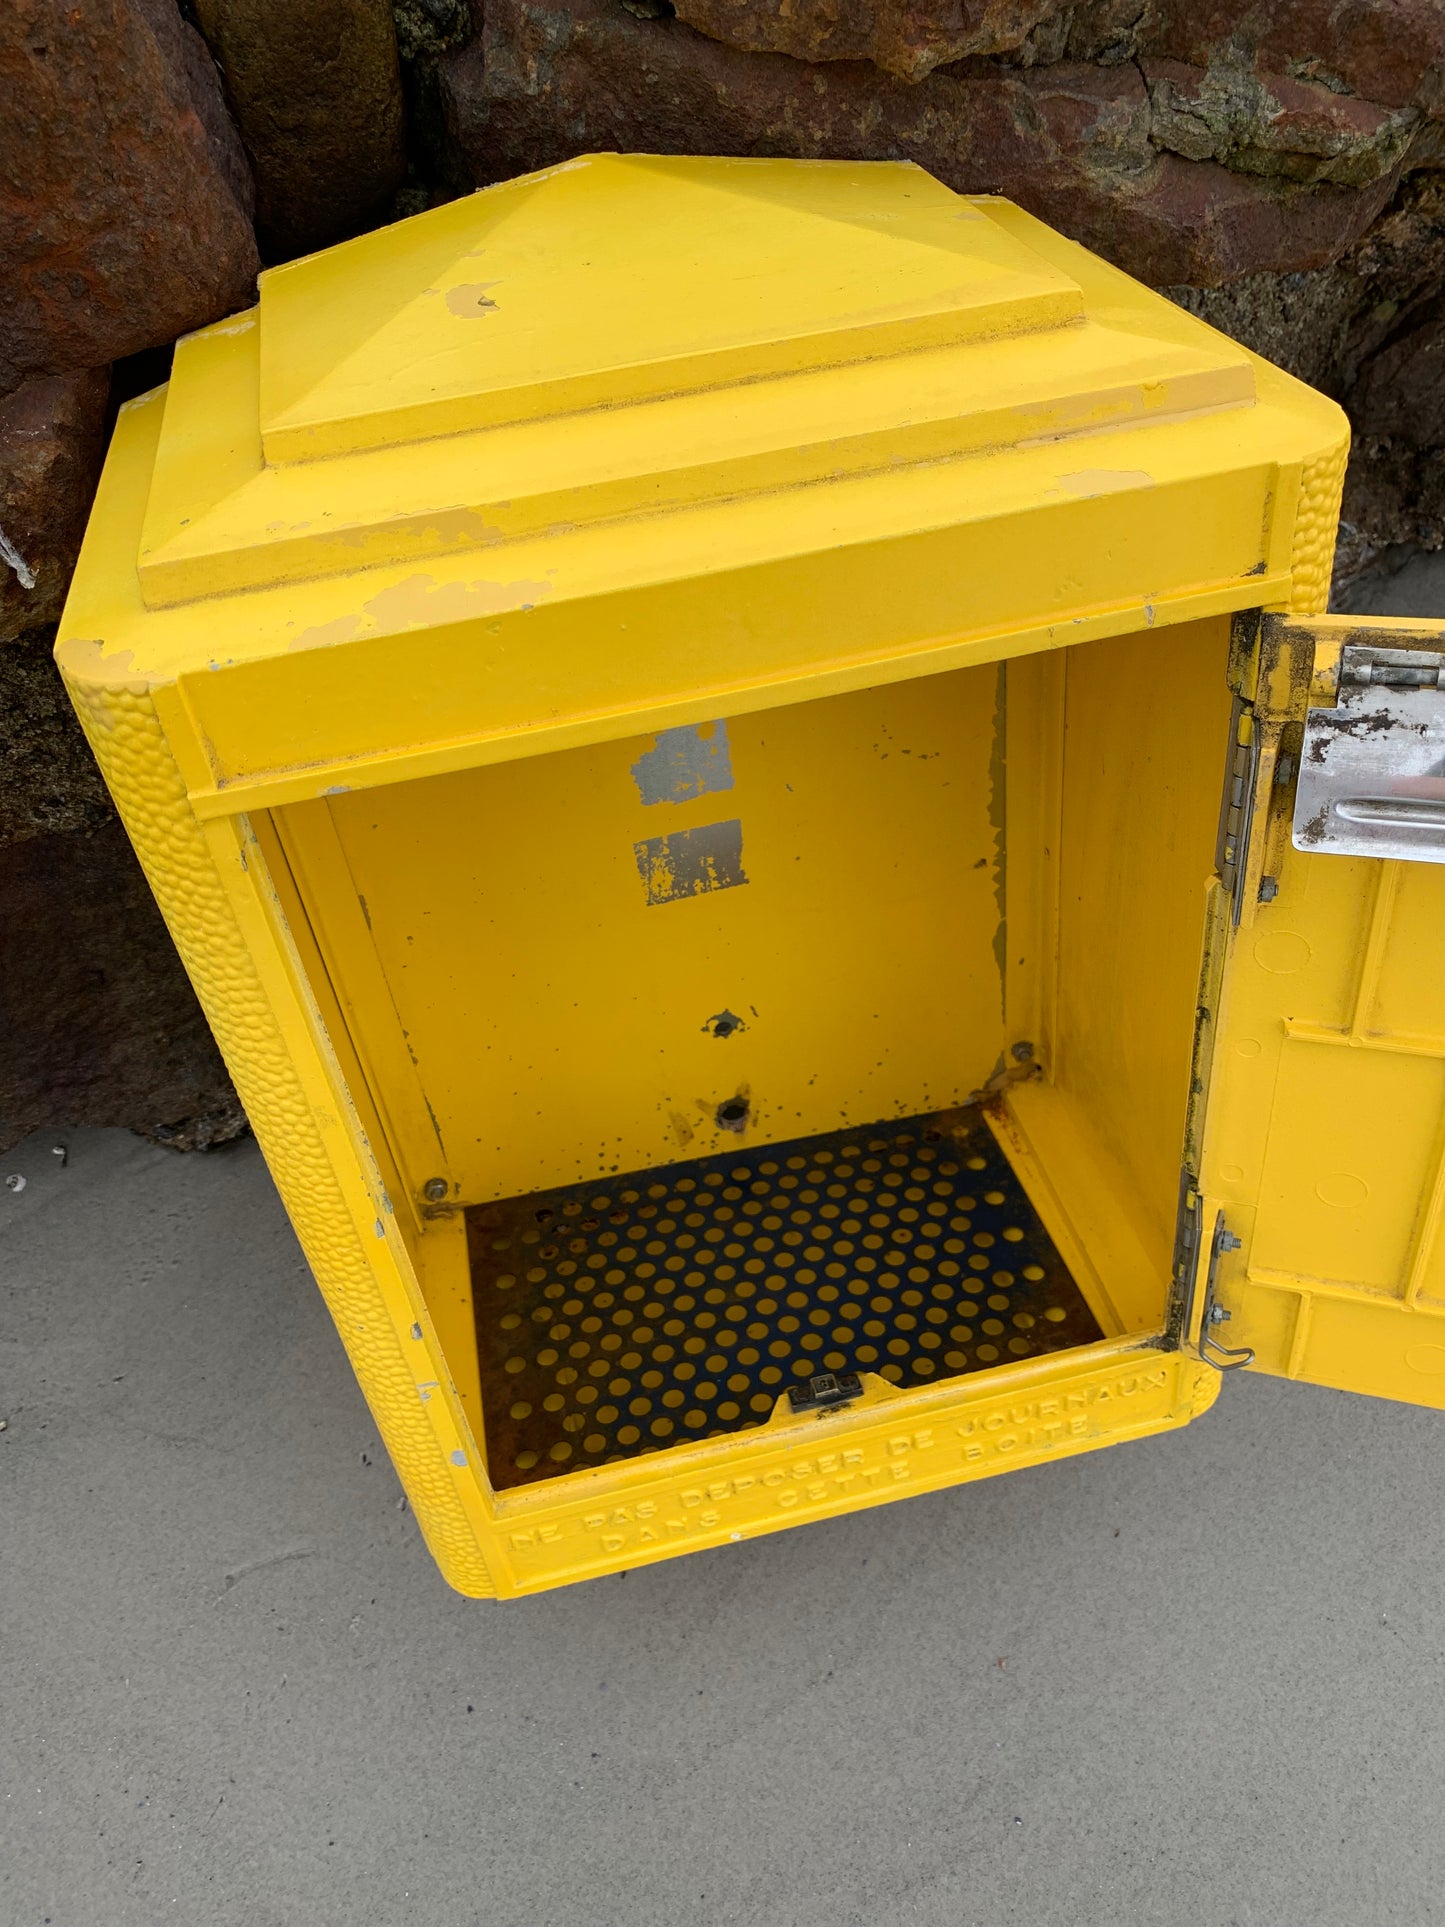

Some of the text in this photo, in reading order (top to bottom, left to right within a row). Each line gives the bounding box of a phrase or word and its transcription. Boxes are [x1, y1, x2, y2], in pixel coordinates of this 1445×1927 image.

[509, 1370, 1168, 1550] NE PAS DEPOSER DE JOURNAUX
[602, 1413, 1089, 1552] DANS CETTE BOITE
